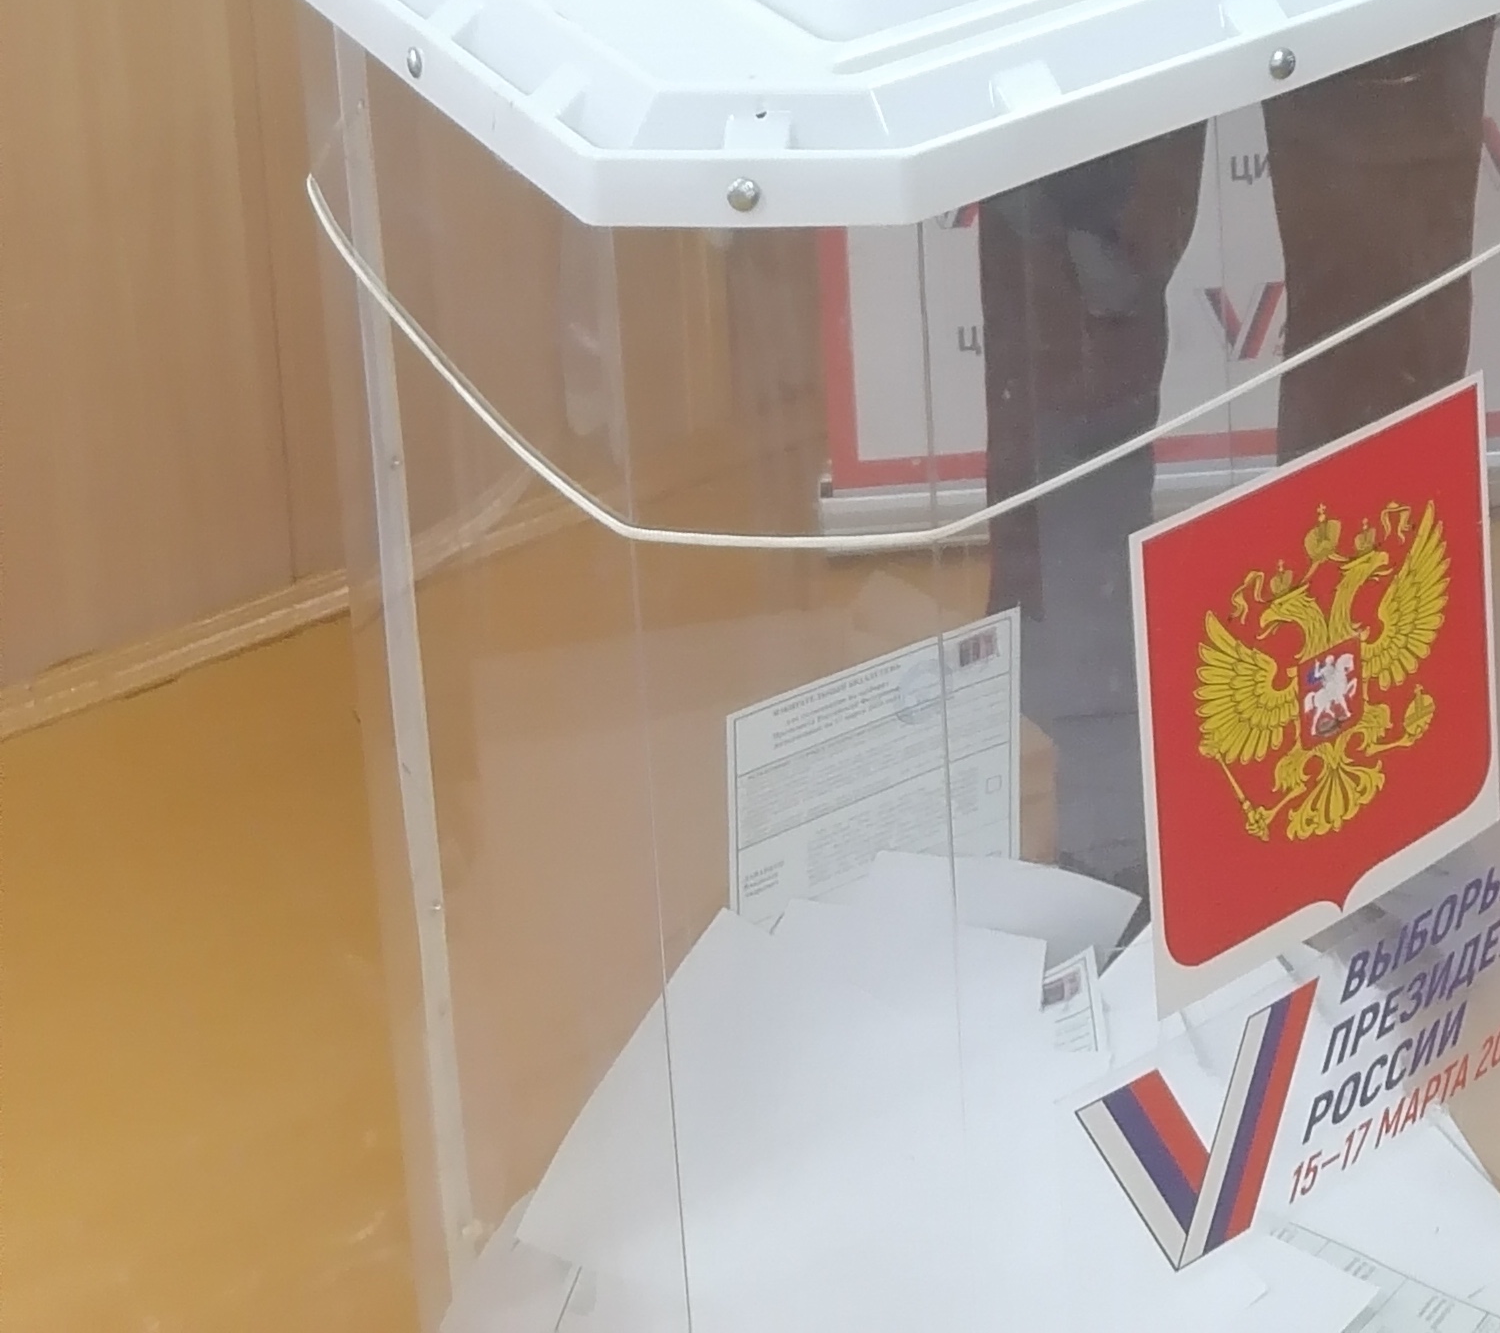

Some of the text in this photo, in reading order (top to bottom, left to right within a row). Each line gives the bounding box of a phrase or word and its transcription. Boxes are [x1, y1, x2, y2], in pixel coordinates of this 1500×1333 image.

[1288, 1121, 1373, 1205] 15–17
[1374, 1055, 1469, 1150] МАРТА
[1302, 1000, 1467, 1145] РОССИИ
